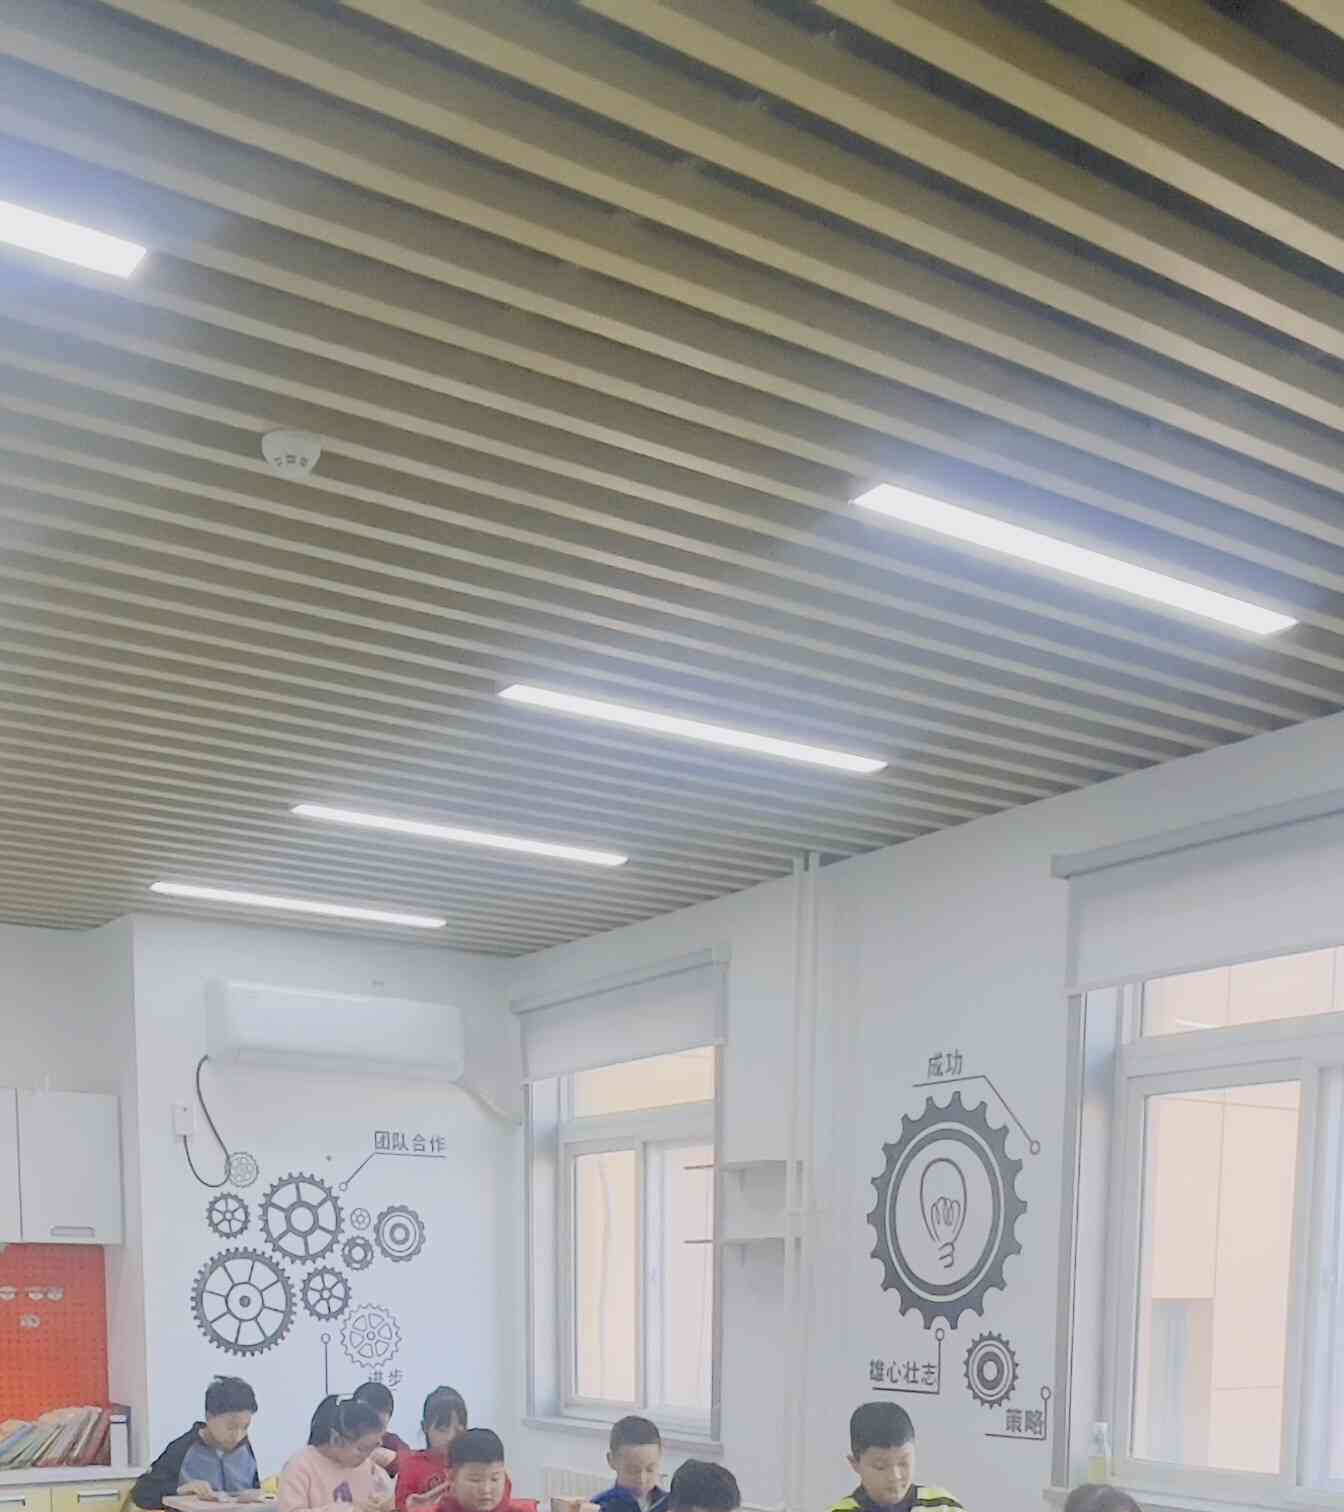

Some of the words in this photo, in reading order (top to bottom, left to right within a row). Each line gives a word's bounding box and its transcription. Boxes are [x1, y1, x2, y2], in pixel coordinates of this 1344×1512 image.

[927, 1048, 963, 1077] 成功
[374, 1130, 448, 1153] 团队合作
[869, 1359, 937, 1386] 雄心壮志
[1006, 1408, 1044, 1436] 策略
